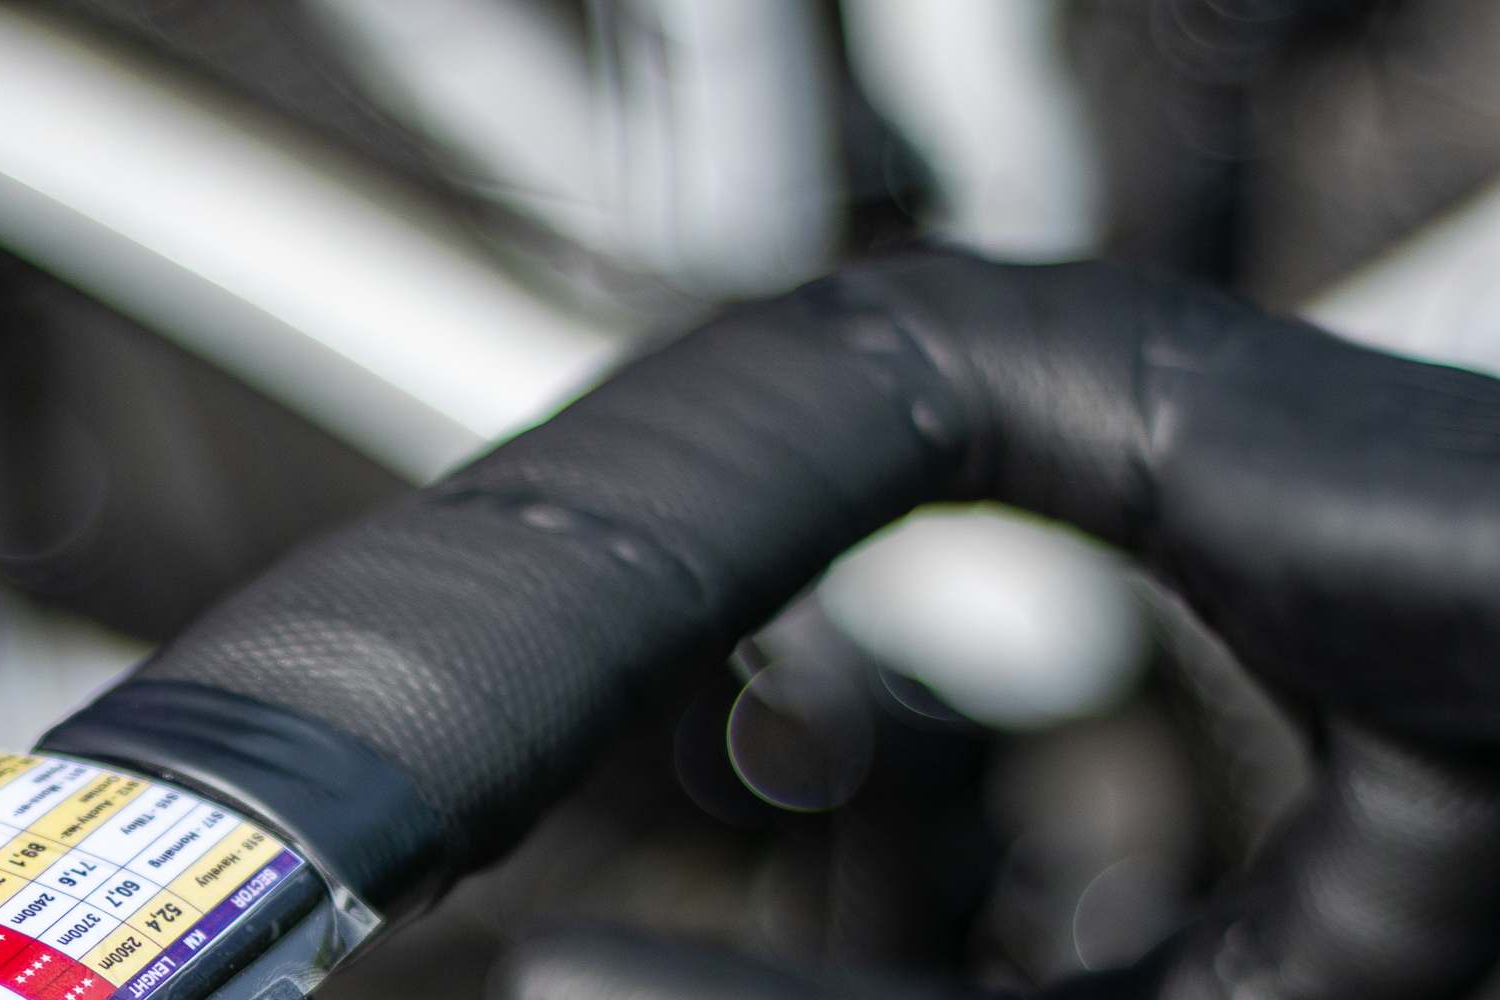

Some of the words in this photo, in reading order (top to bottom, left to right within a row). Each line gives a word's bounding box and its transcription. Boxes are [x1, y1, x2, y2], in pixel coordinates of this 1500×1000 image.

[155, 793, 179, 809] S15
[120, 813, 156, 835] Tilloy
[202, 811, 224, 828] S17
[8, 842, 47, 867] 89,1
[148, 831, 201, 869] Hornaing
[241, 832, 264, 851] S18
[58, 861, 97, 887] 71,6
[194, 852, 241, 888] Haveluy
[105, 880, 141, 908] 60,7
[230, 868, 277, 908] SECTOR
[10, 892, 56, 924] 2400m
[145, 903, 182, 933] 52,4
[56, 913, 101, 946] 3700m
[183, 929, 207, 950] KM
[98, 936, 142, 970] 2500m
[129, 955, 176, 999] LENGHT
